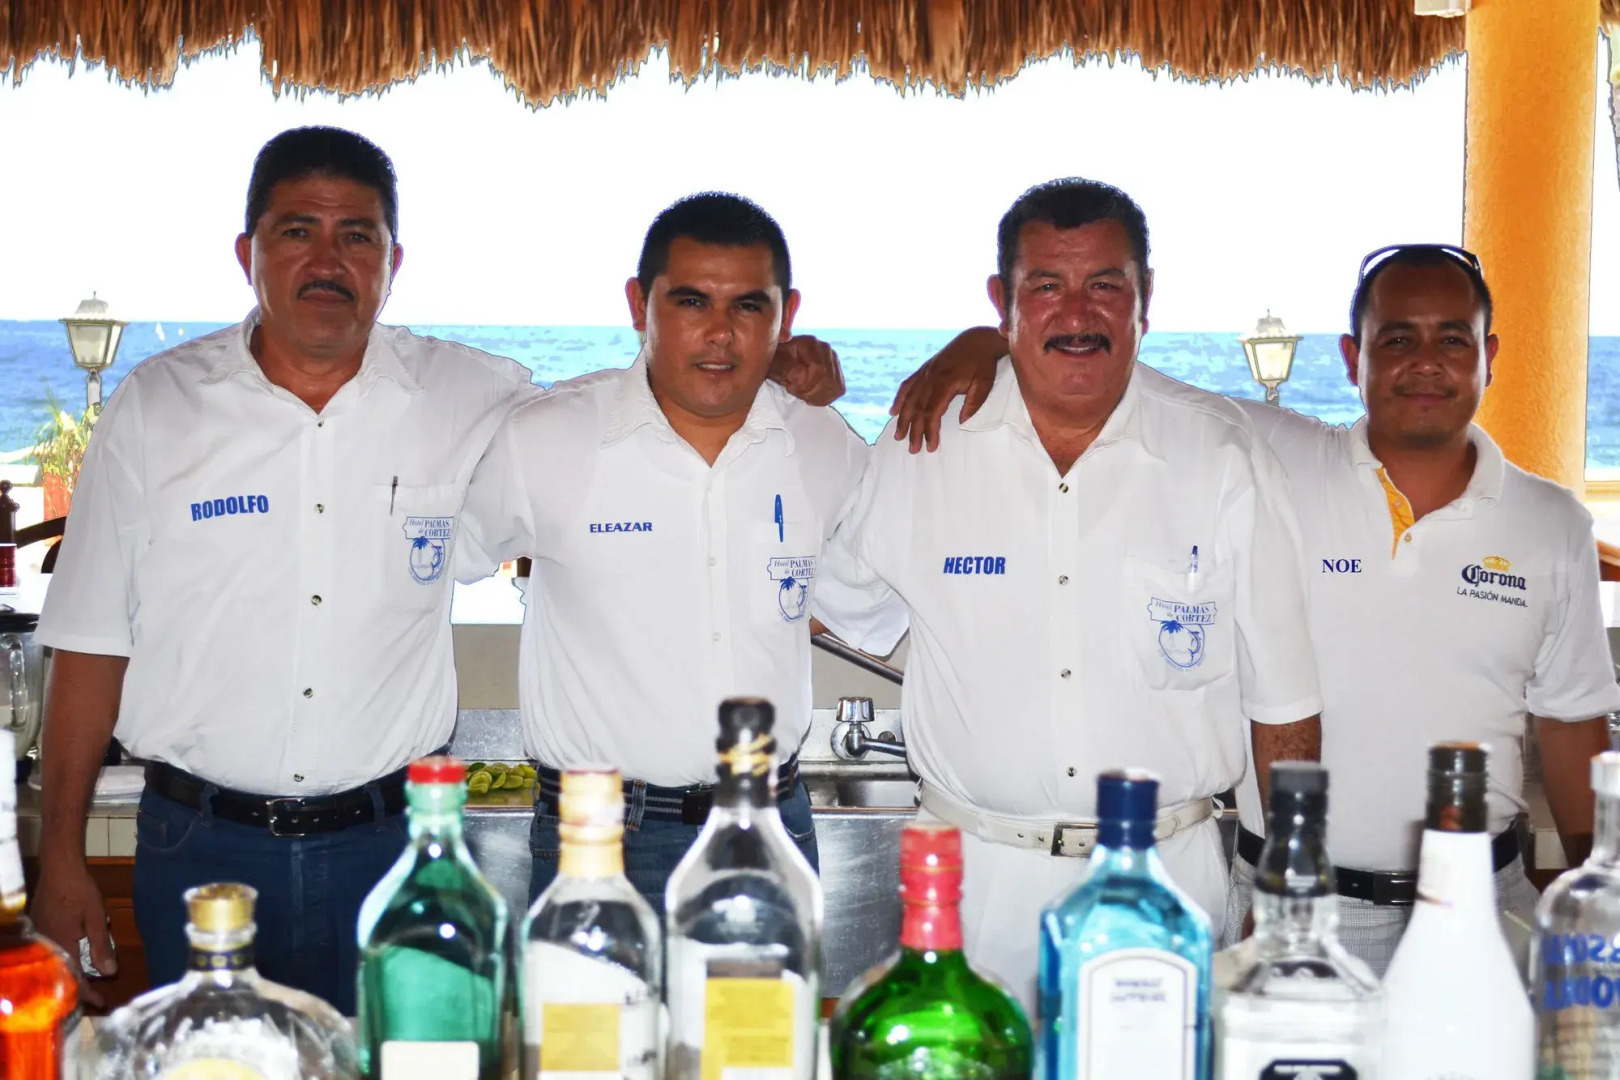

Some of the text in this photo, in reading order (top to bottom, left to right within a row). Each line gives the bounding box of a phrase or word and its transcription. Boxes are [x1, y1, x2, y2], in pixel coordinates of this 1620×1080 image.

[190, 495, 269, 521] RODOLFO
[424, 519, 450, 528] PALMAS
[589, 521, 653, 533] ELEAZAR
[424, 528, 451, 537] CORTEZ
[943, 556, 1006, 575] HECTOR
[1321, 558, 1362, 573] NOE
[1461, 564, 1527, 591] Corona
[1456, 586, 1467, 596] LA
[1470, 589, 1499, 601] PASIÓN
[1174, 604, 1210, 614] PALMAS
[1176, 613, 1212, 623] CORTEZ
